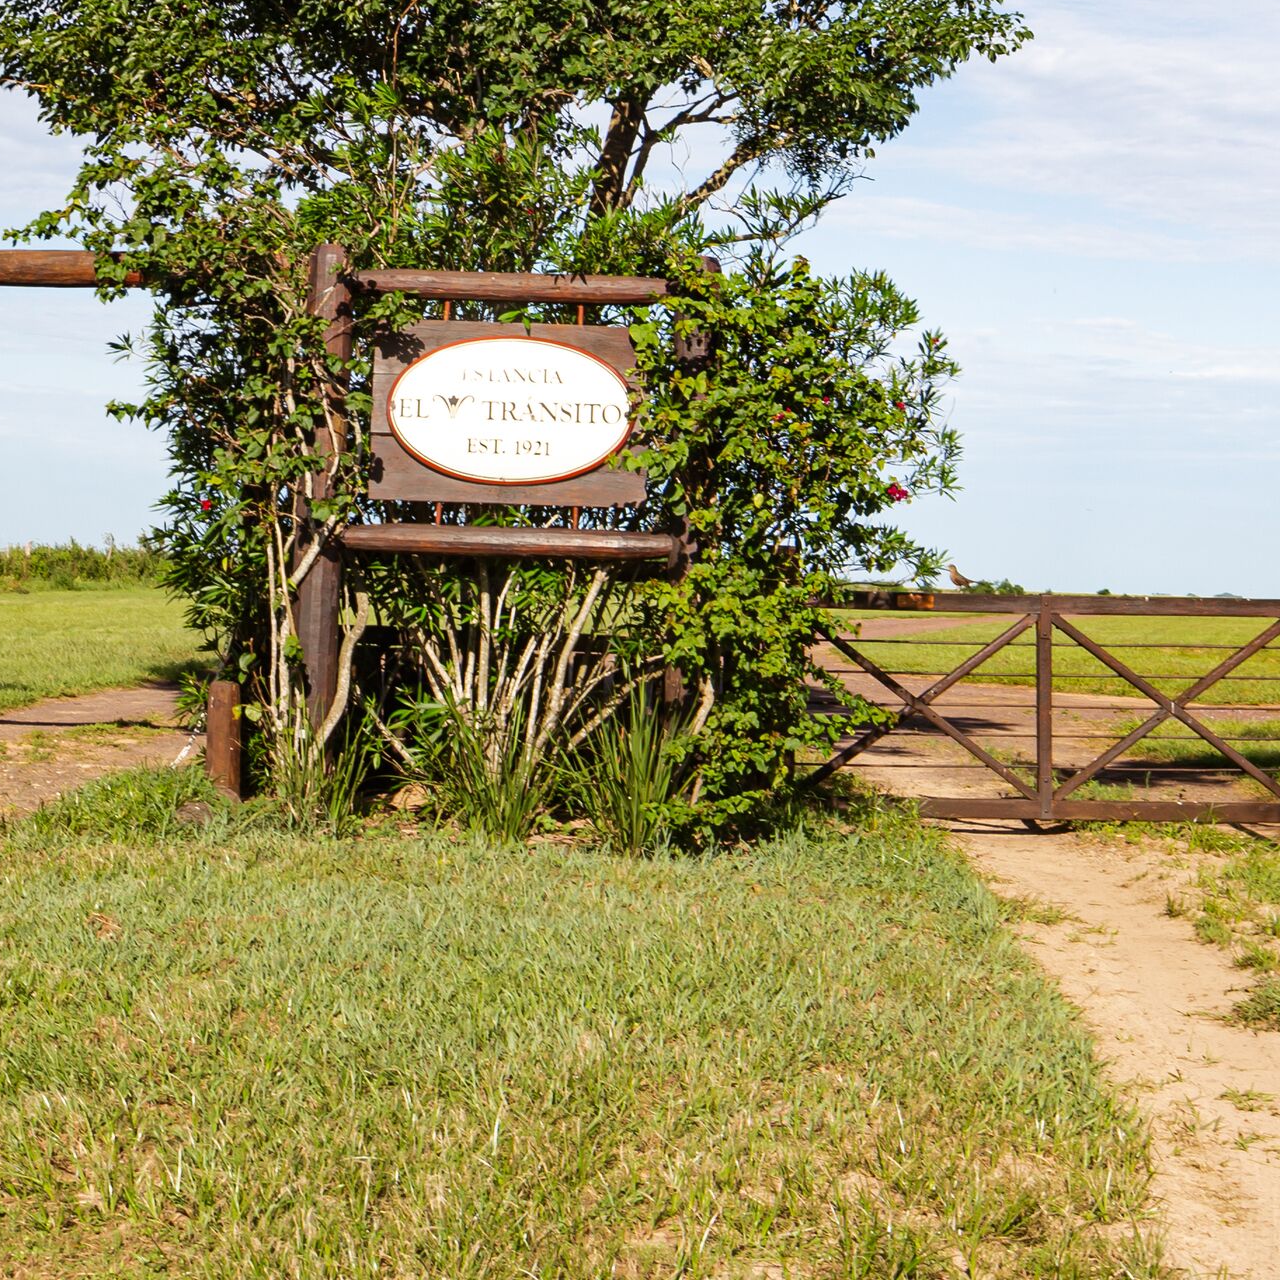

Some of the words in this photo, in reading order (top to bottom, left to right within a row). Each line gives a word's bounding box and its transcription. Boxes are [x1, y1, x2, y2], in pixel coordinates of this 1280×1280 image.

[399, 398, 430, 419] EL
[481, 395, 622, 425] TRÁNSITO
[467, 437, 506, 455] EST.
[515, 439, 551, 457] 1921
